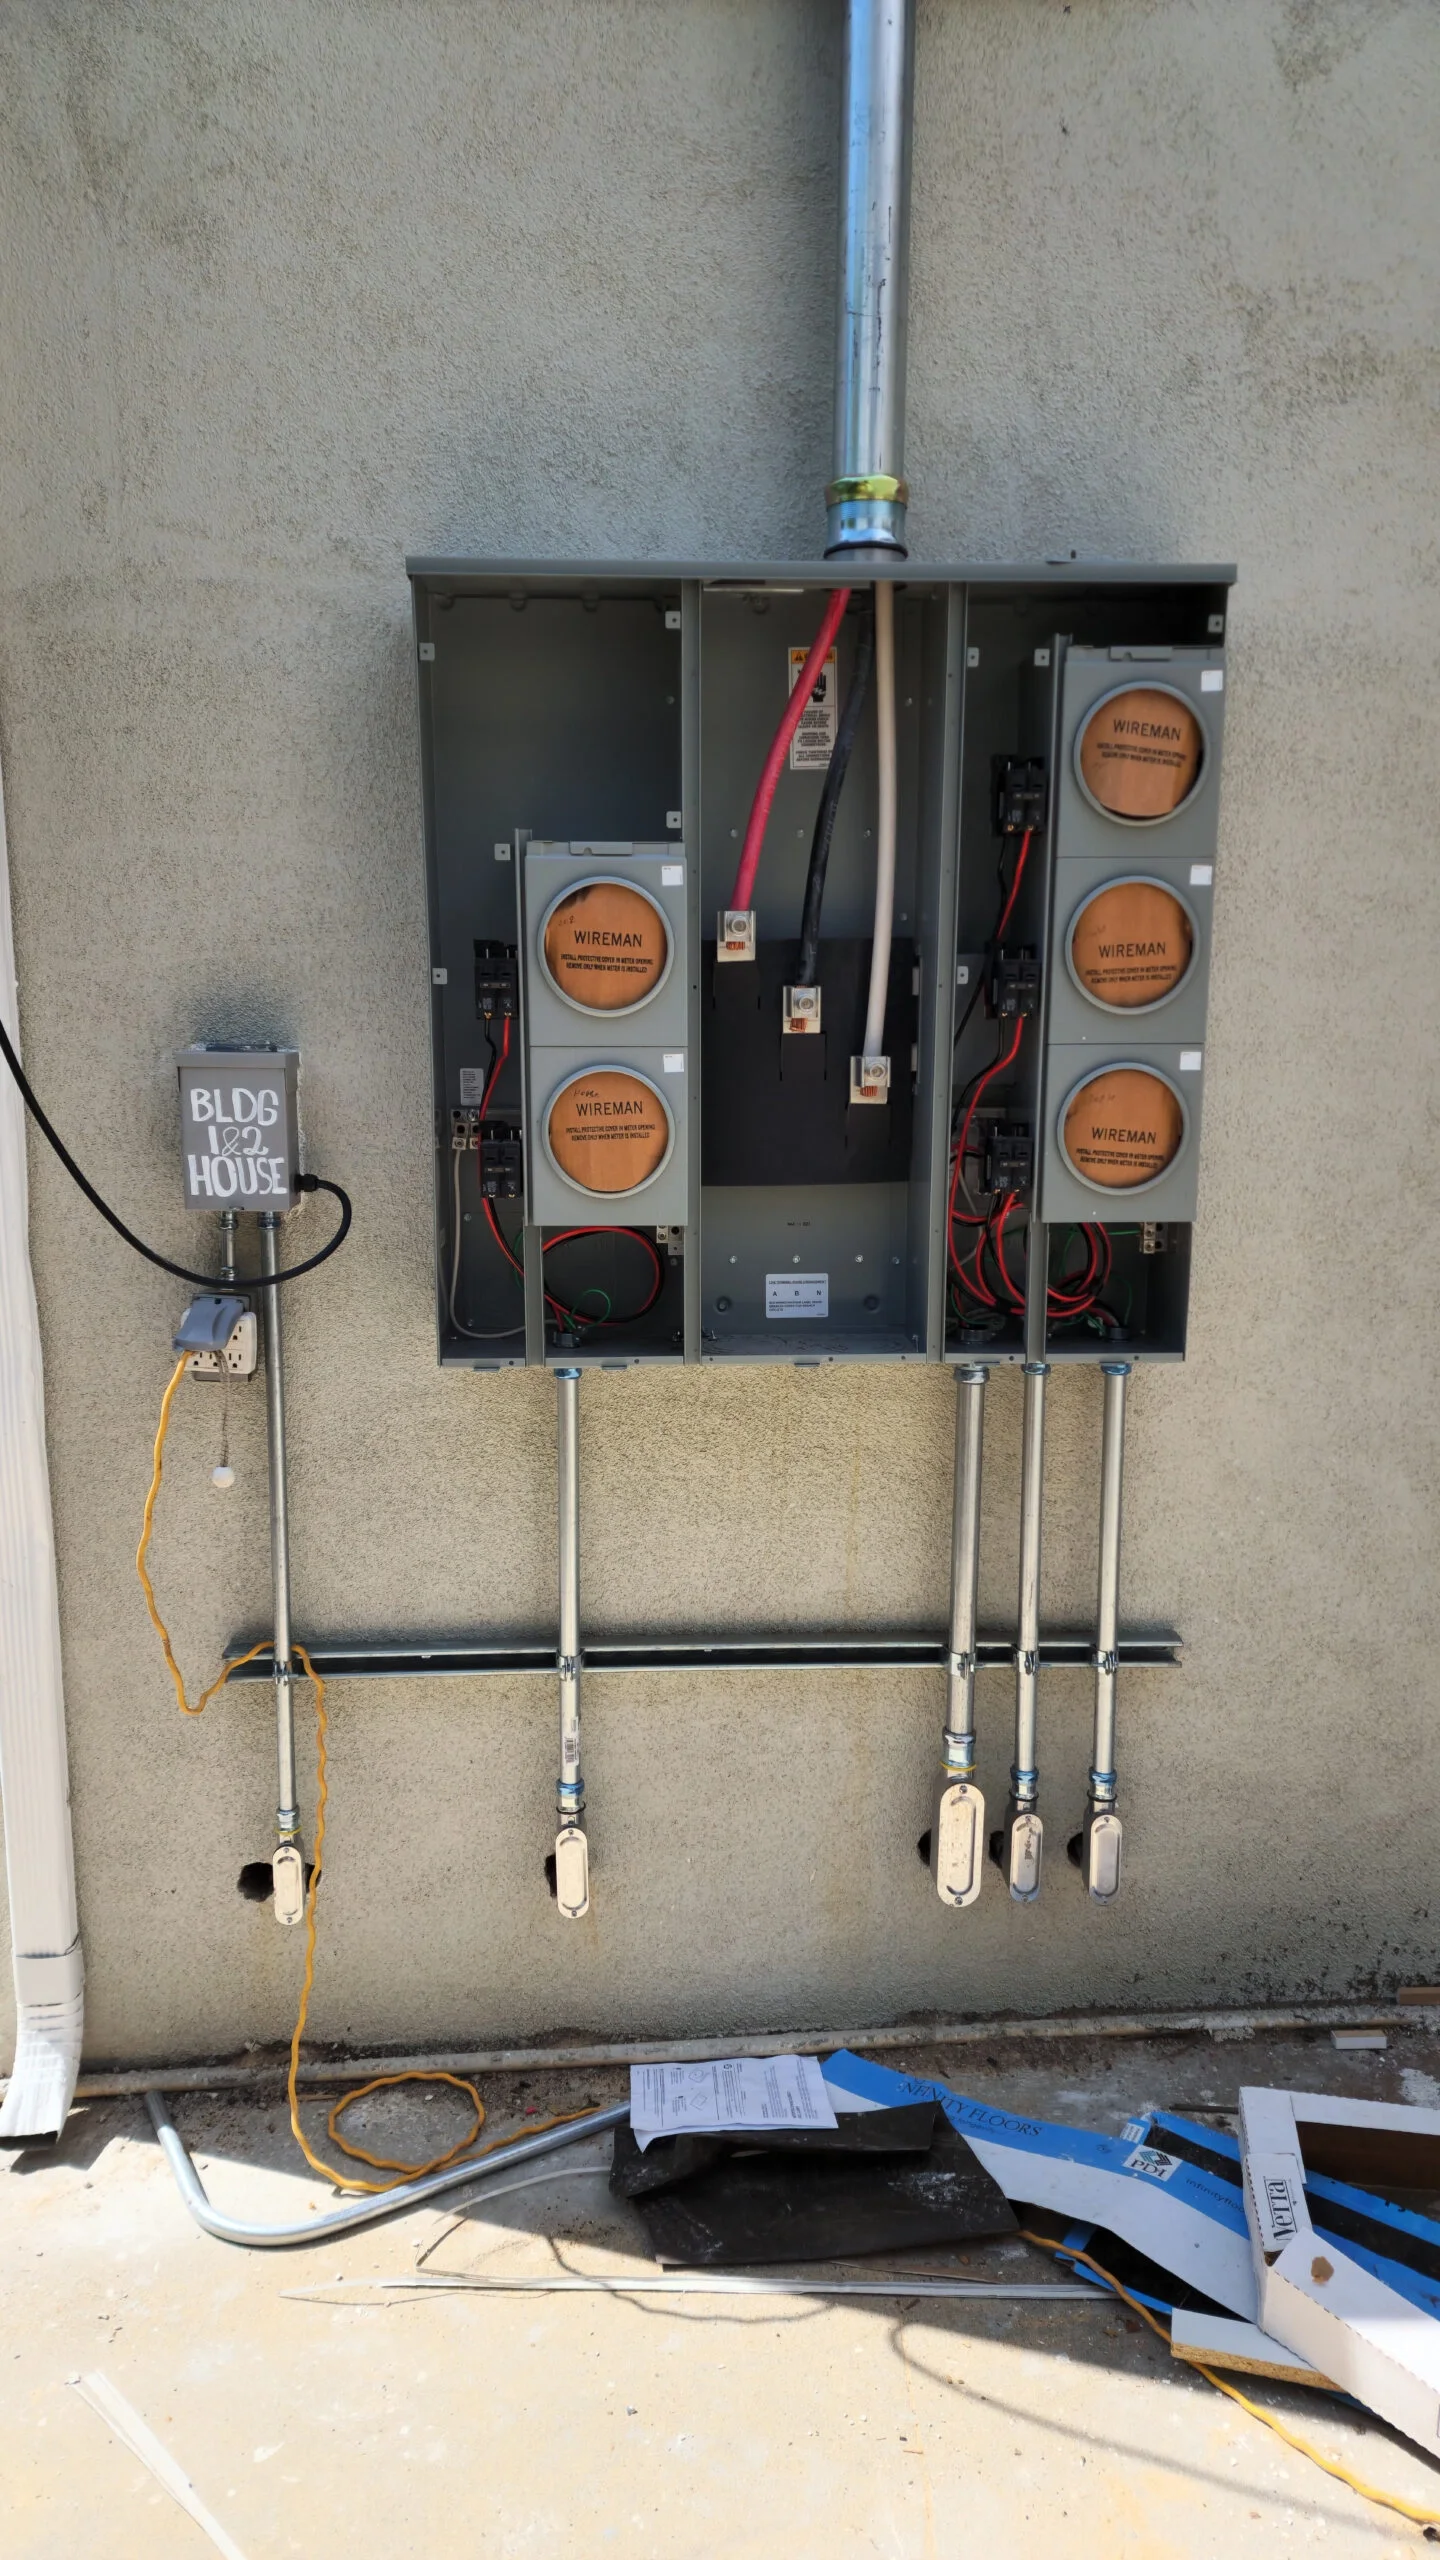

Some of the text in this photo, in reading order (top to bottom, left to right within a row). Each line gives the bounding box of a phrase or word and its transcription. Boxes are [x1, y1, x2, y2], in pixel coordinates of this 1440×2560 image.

[1114, 719, 1181, 741] WIREMAN
[574, 930, 642, 947] WIREMAN
[1099, 942, 1166, 958] WIREMAN
[190, 1088, 279, 1126] BLDG
[576, 1101, 643, 1116] WIREMAN
[208, 1126, 269, 1157] 1&2
[1091, 1127, 1157, 1144] WIREMAN
[187, 1154, 288, 1197] HOUSE
[968, 2107, 1043, 2136] FLOORS
[1130, 2158, 1167, 2178] PDI
